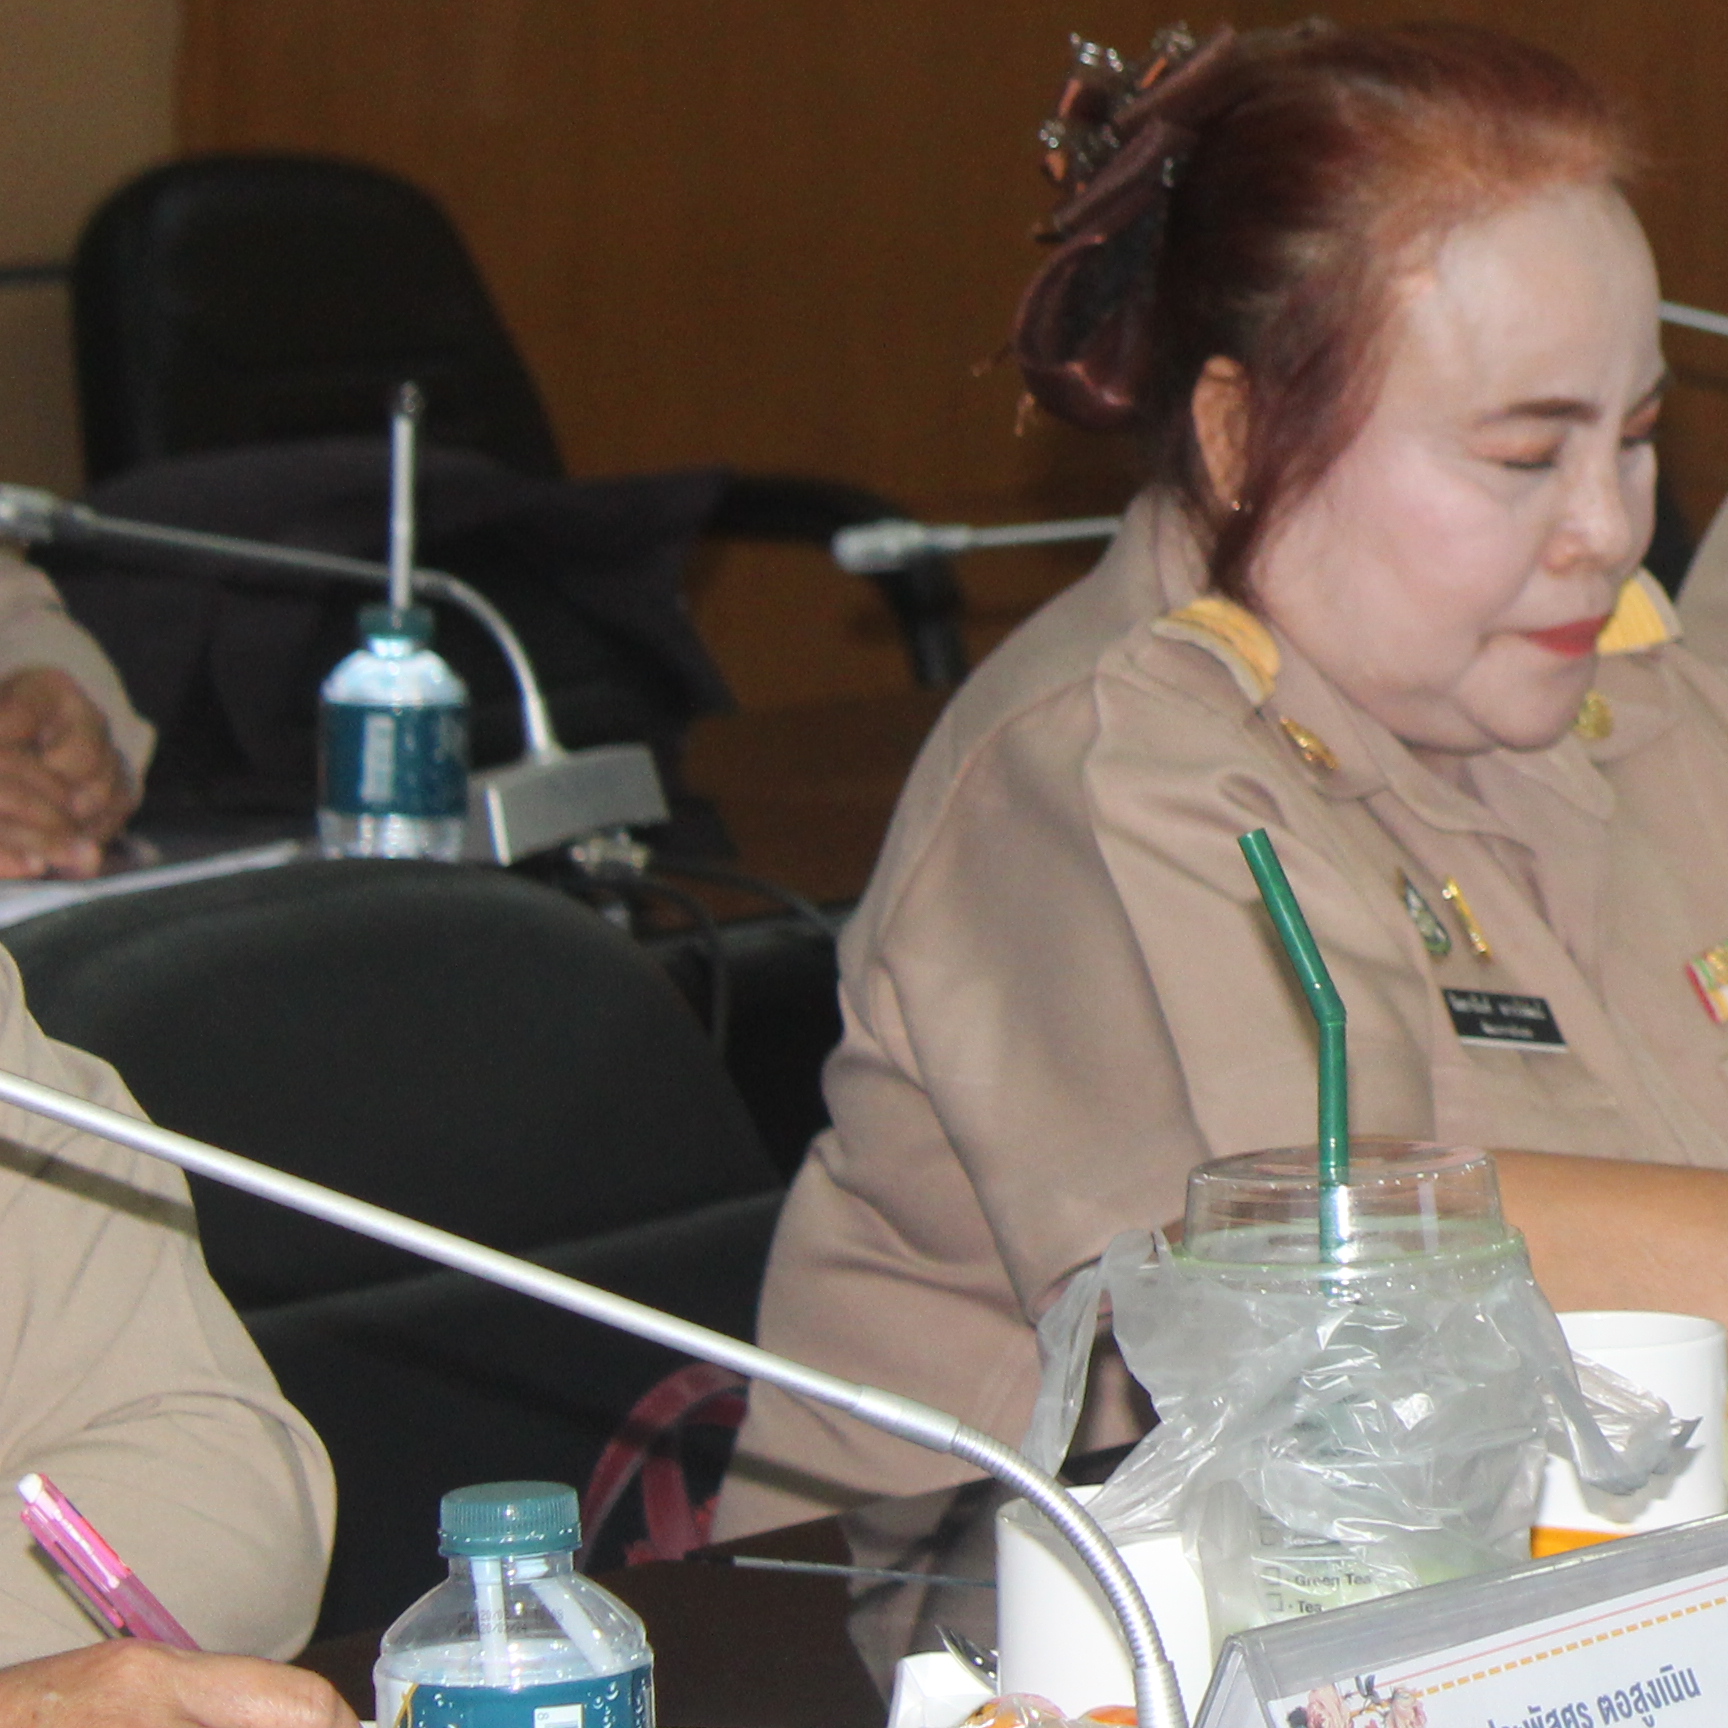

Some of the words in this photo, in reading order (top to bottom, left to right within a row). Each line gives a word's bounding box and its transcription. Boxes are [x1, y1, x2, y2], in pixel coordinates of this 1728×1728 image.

[1295, 1575, 1340, 1587] Green
[1346, 1573, 1372, 1586] Tea
[1298, 1600, 1323, 1613] Tea
[1597, 1663, 1702, 1728] ตอสูงเนิน
